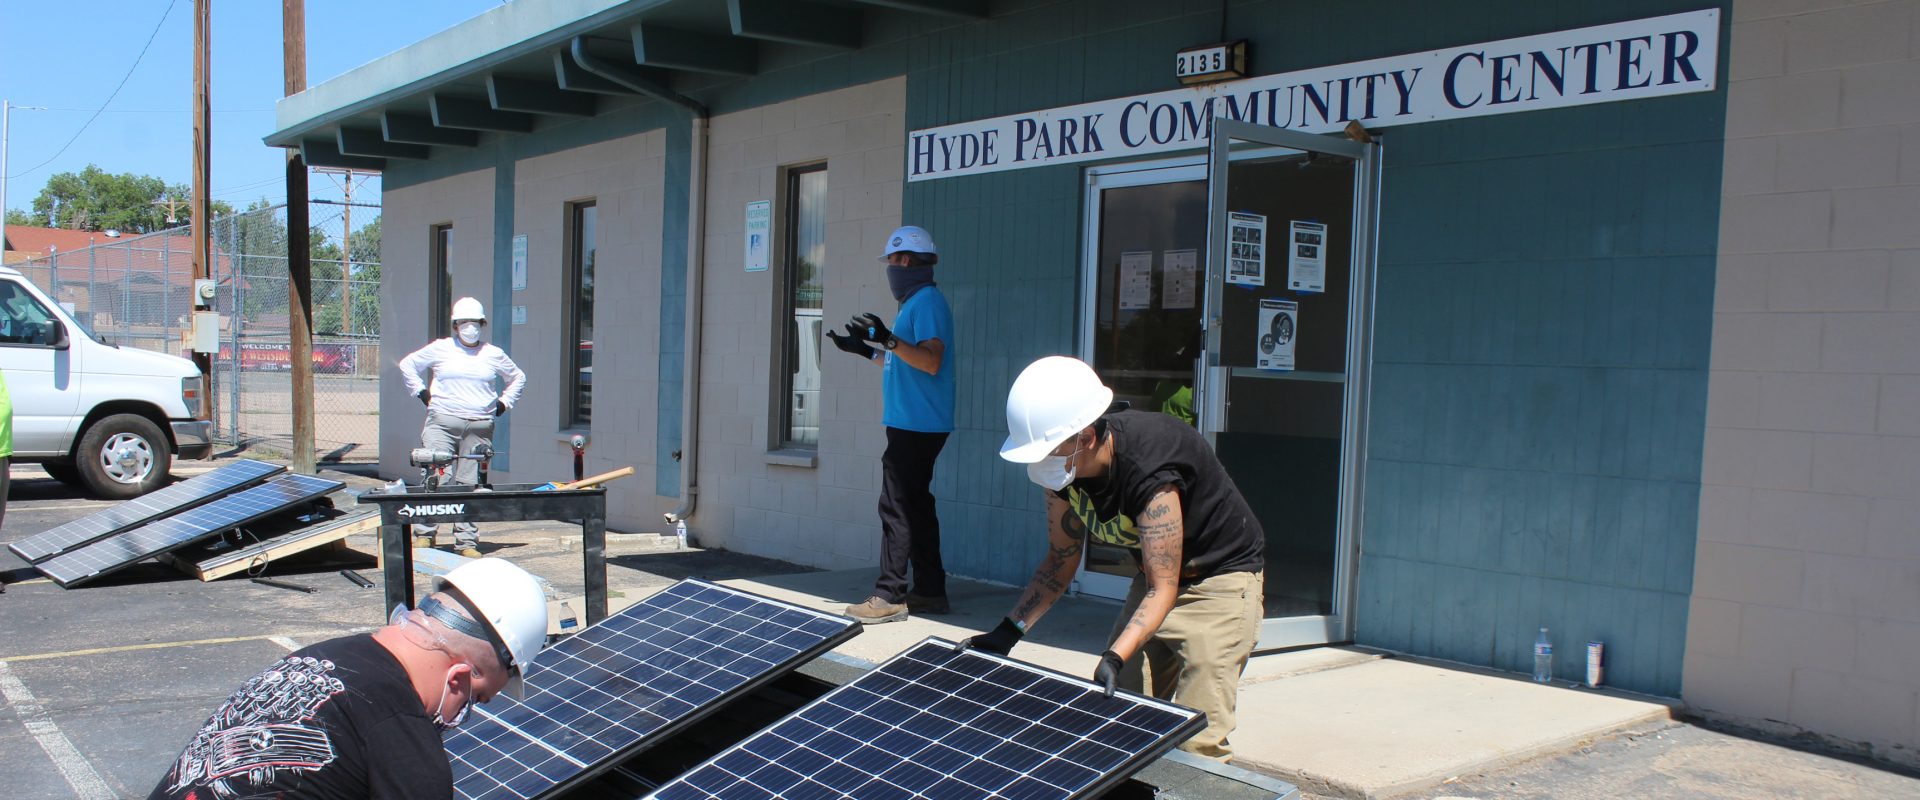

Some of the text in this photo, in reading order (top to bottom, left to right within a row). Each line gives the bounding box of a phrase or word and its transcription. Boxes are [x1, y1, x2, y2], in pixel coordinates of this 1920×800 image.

[1177, 52, 1221, 75] 2135
[911, 30, 1702, 176] HYDE PARK COMMUNITY CENTER
[415, 504, 465, 516] HUSKY
